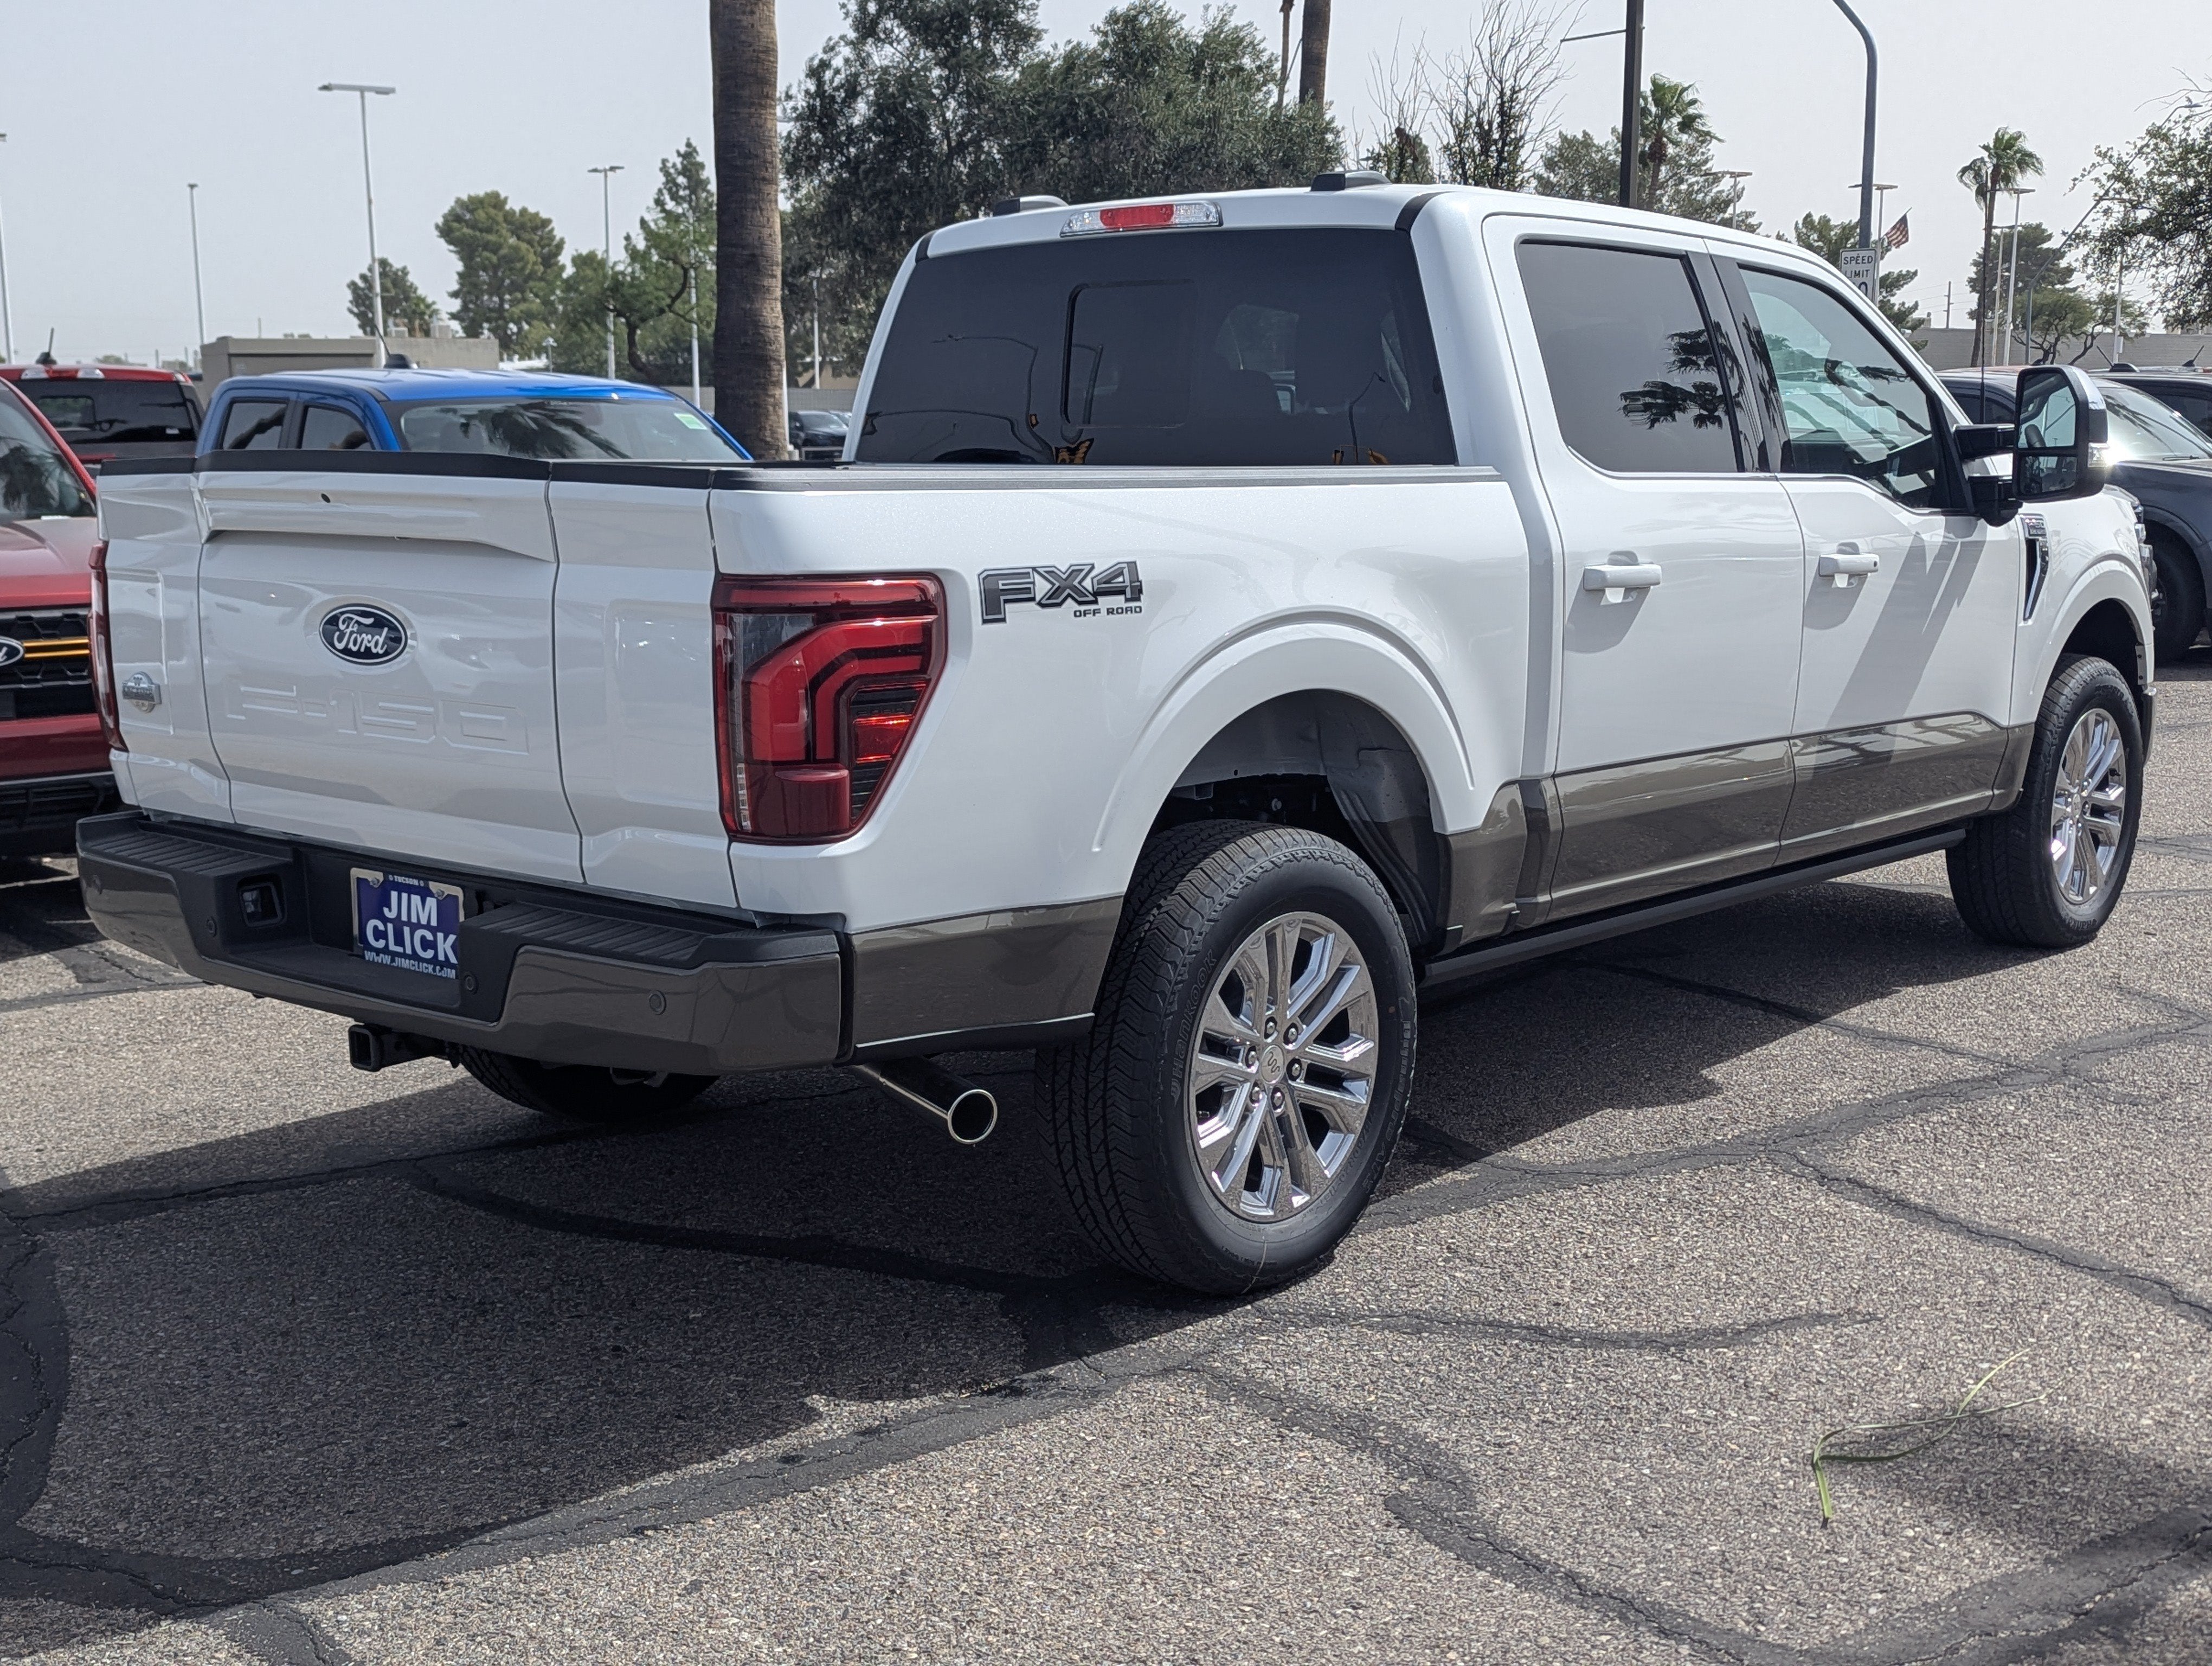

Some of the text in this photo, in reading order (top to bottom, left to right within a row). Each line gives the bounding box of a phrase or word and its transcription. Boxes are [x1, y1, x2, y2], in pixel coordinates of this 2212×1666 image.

[1843, 255, 1873, 265] SPEED
[1844, 269, 1870, 278] LIMIT
[978, 561, 1143, 625] FX4
[1073, 606, 1142, 618] OFF ROAD
[334, 613, 389, 654] Ford
[383, 890, 438, 926] JIM
[366, 919, 459, 964] CLICK
[364, 950, 456, 979] WWW.JIMCLICK.COM
